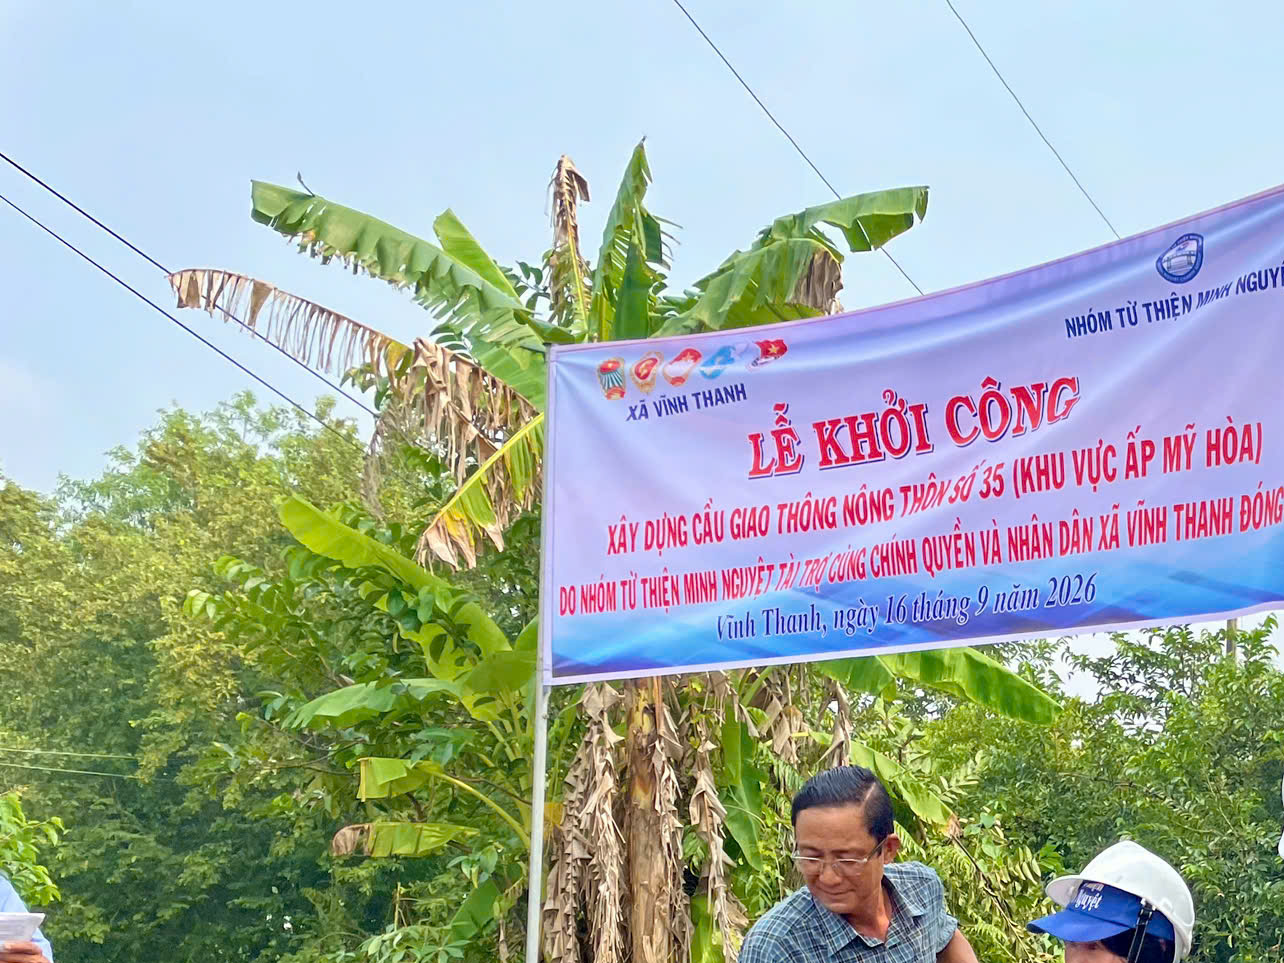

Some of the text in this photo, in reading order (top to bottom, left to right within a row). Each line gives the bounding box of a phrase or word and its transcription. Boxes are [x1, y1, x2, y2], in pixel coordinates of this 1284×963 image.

[1065, 308, 1113, 338] NHÓM
[1115, 300, 1138, 328] TỪ
[1142, 292, 1193, 322] THIỆN
[1195, 281, 1233, 310] MINH
[626, 383, 747, 422] XÃ VĨNH THANH
[748, 375, 1080, 480] LỄ KHỞI CÔNG
[607, 416, 1263, 557] XÂY DỰNG CẦU GIAO THÔNG NÔNG THÔN SỐ 35 (KHU VỰC ẤP MỸ HÒA)
[559, 585, 576, 616] DO
[580, 574, 617, 614] NHÓM
[620, 570, 638, 610] TỪ
[641, 566, 681, 614] THIỆN
[683, 570, 719, 605] MINH
[721, 556, 775, 600] NGUYỆT
[774, 553, 800, 592] TÀI
[799, 552, 833, 592] TRỢ
[869, 533, 919, 578] CHÍNH
[922, 517, 976, 578] QUYỀN
[979, 519, 1002, 565] VÀ
[1007, 513, 1054, 563] NHÂN
[1059, 508, 1094, 557] DÂN
[1098, 503, 1120, 551] XÃ
[1127, 499, 1167, 547] VĨNH
[1173, 497, 1234, 541] THANH
[1239, 481, 1284, 532] ĐÓNG
[717, 572, 1097, 640] Vĩnh Thanh, ngày 16 tháng 9 năm 2026
